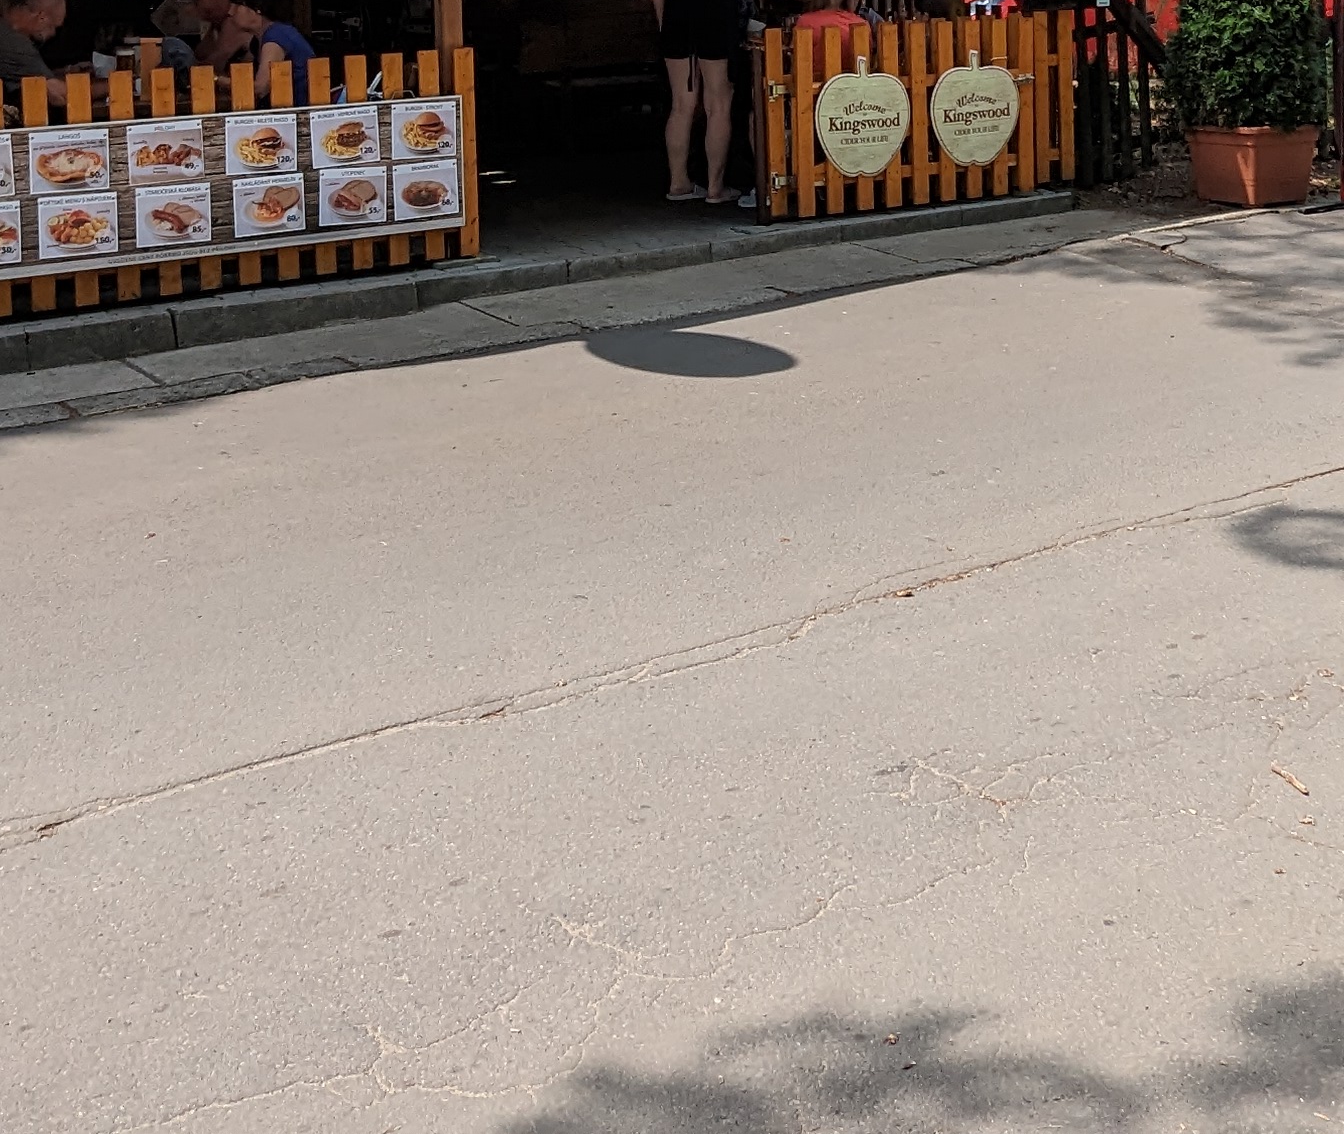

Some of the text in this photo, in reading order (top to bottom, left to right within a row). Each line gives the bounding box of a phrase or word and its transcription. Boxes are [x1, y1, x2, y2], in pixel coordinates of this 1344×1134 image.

[842, 101, 886, 116] Welcome
[955, 92, 997, 108] Welcome
[828, 111, 901, 136] Kingswood
[942, 102, 1010, 126] Kingswood
